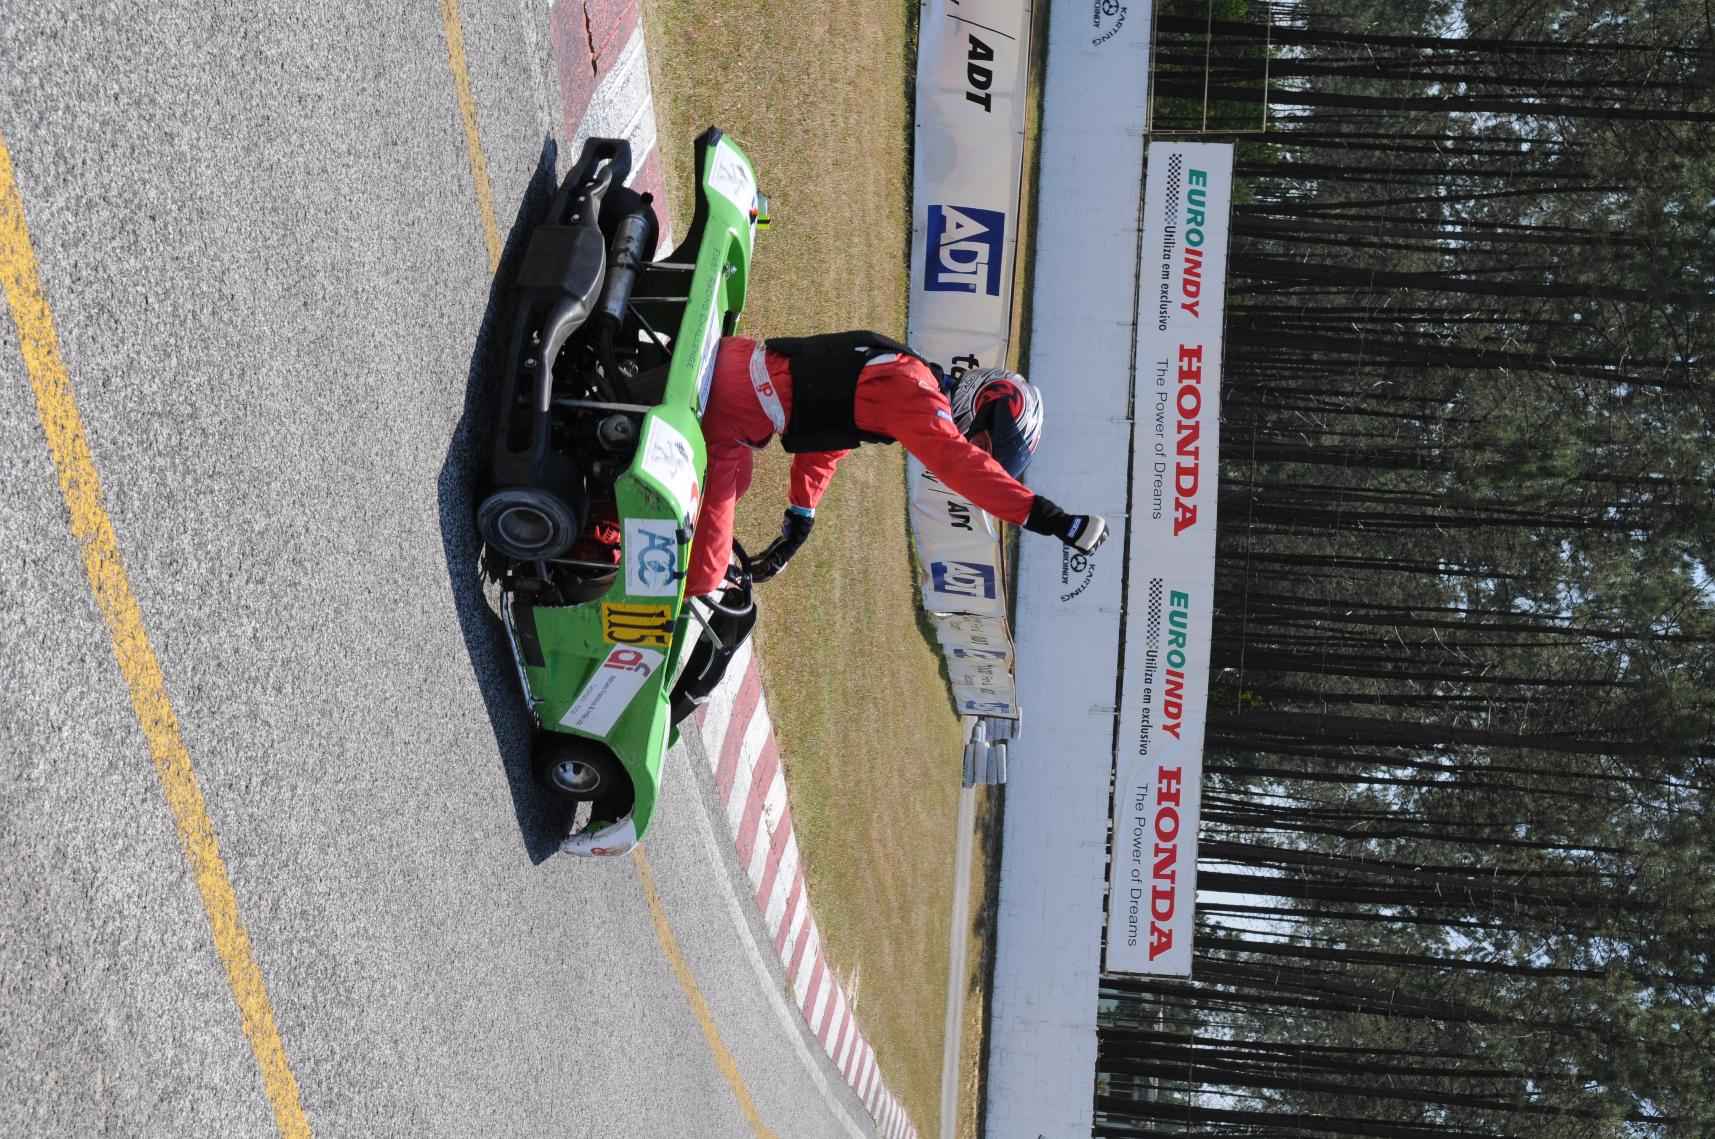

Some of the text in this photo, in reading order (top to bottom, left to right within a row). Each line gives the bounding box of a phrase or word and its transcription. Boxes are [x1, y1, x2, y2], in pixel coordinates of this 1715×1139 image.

[966, 33, 994, 113] ADT
[1092, 7, 1128, 46] KARTING
[938, 205, 990, 294] ADT
[1158, 226, 1176, 332] Utiliza em exclusivo
[1181, 169, 1208, 318] EUROINDY
[686, 314, 709, 369] CHALLENGE
[1152, 358, 1168, 520] The Power of Dreams
[1174, 344, 1202, 536] HONDA
[607, 607, 667, 644] 115
[942, 561, 984, 598] ADT
[1061, 564, 1096, 602] KARTING
[1139, 650, 1158, 756] Utiliza em exclusivo
[1162, 590, 1189, 740] EUROINDY
[1127, 783, 1148, 946] The Power of Dreams
[1149, 766, 1182, 962] HONDA
